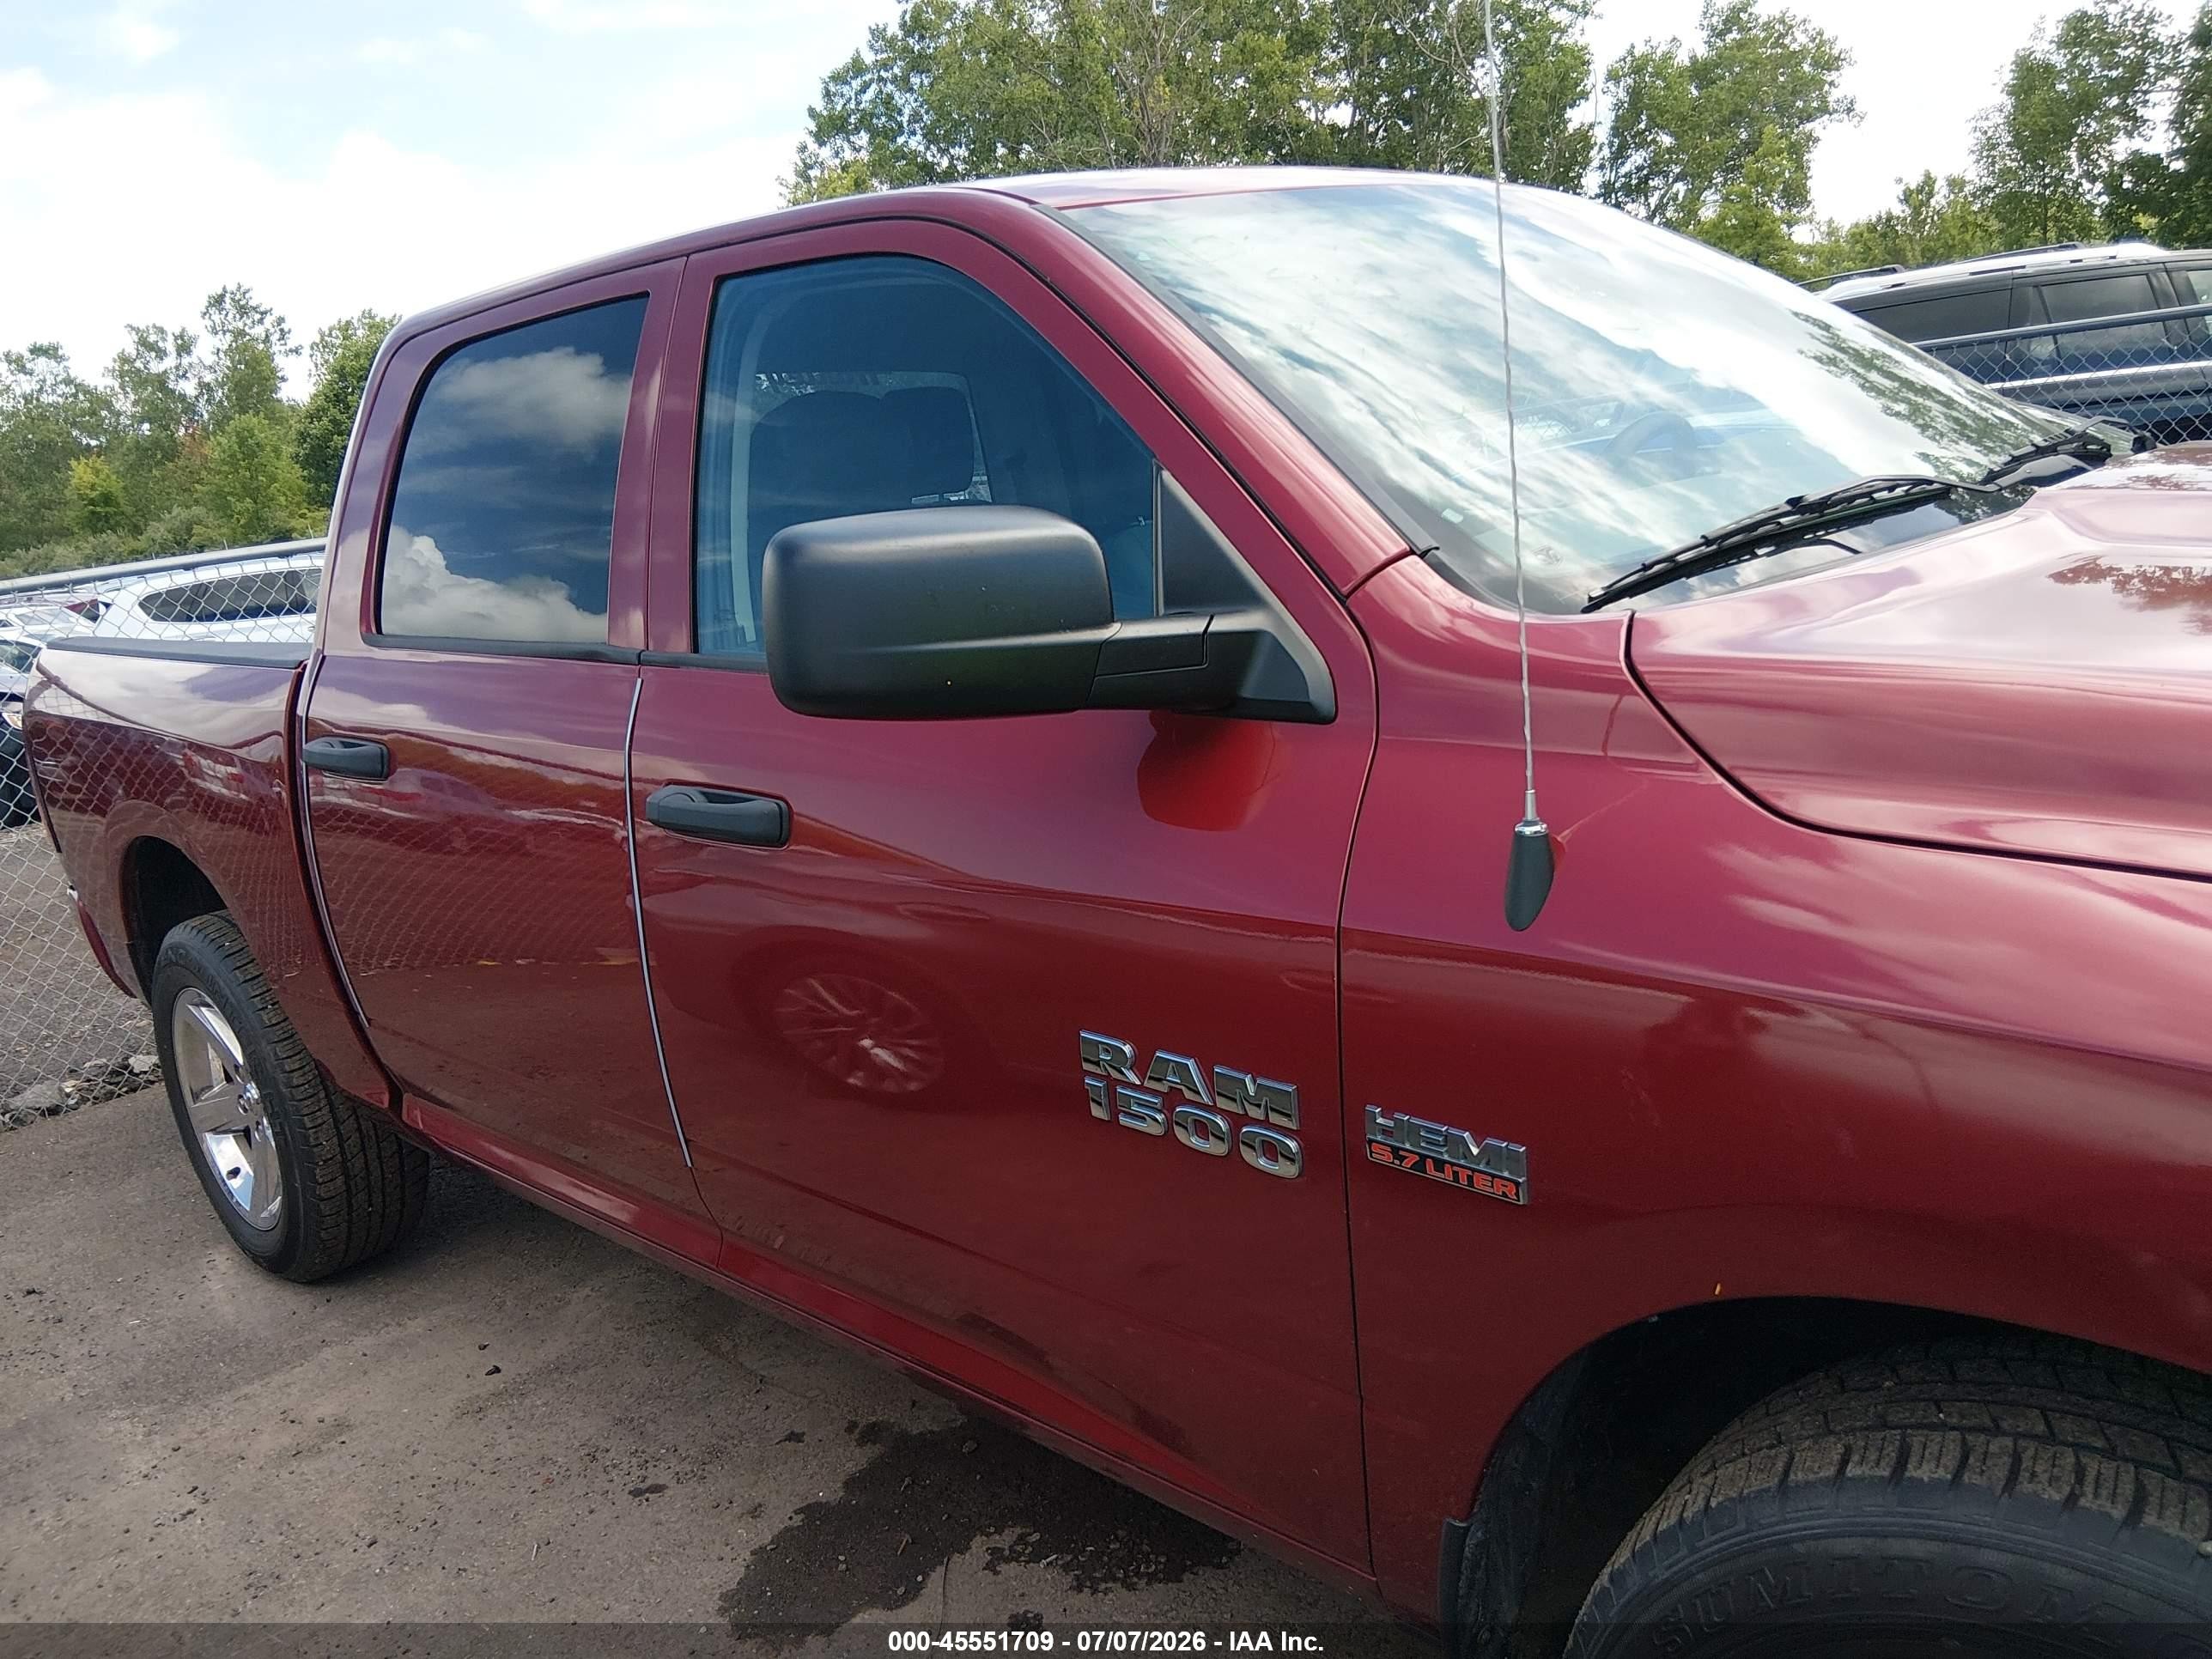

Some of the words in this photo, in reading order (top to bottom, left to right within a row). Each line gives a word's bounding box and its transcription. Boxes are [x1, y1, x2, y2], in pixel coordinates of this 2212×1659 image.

[1079, 1030, 1300, 1130] RAM
[1084, 1075, 1304, 1179] 1500
[1365, 1104, 1526, 1182] HEMI
[1371, 1142, 1420, 1169] 5.7
[1425, 1158, 1518, 1200] LITER
